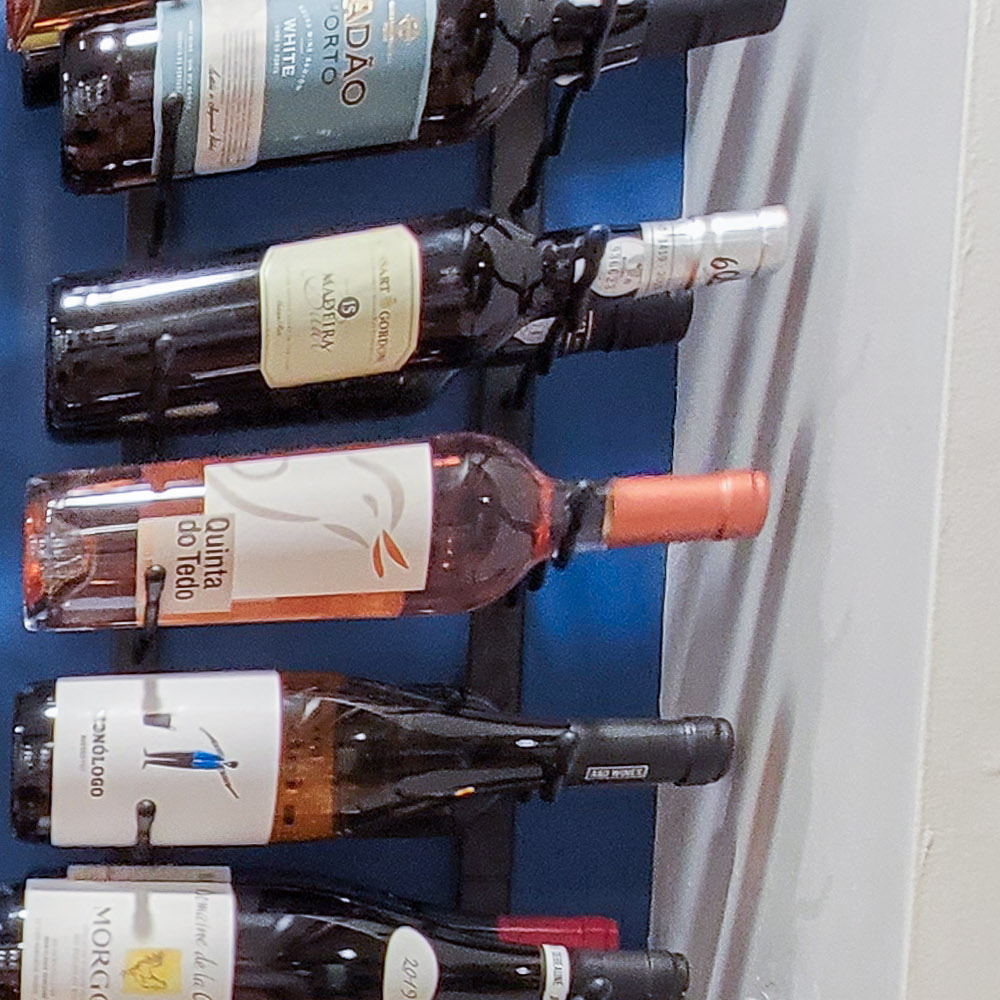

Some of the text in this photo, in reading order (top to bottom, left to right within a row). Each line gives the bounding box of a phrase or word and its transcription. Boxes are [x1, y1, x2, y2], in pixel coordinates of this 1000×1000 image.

[281, 17, 297, 78] WHITE
[320, 4, 340, 86] ORTO
[319, 273, 335, 352] MADEIRA
[174, 519, 202, 601] do Tedo
[202, 517, 231, 590] Quinta
[193, 950, 217, 969] de
[193, 973, 215, 988] la
[401, 957, 420, 999] 2019
